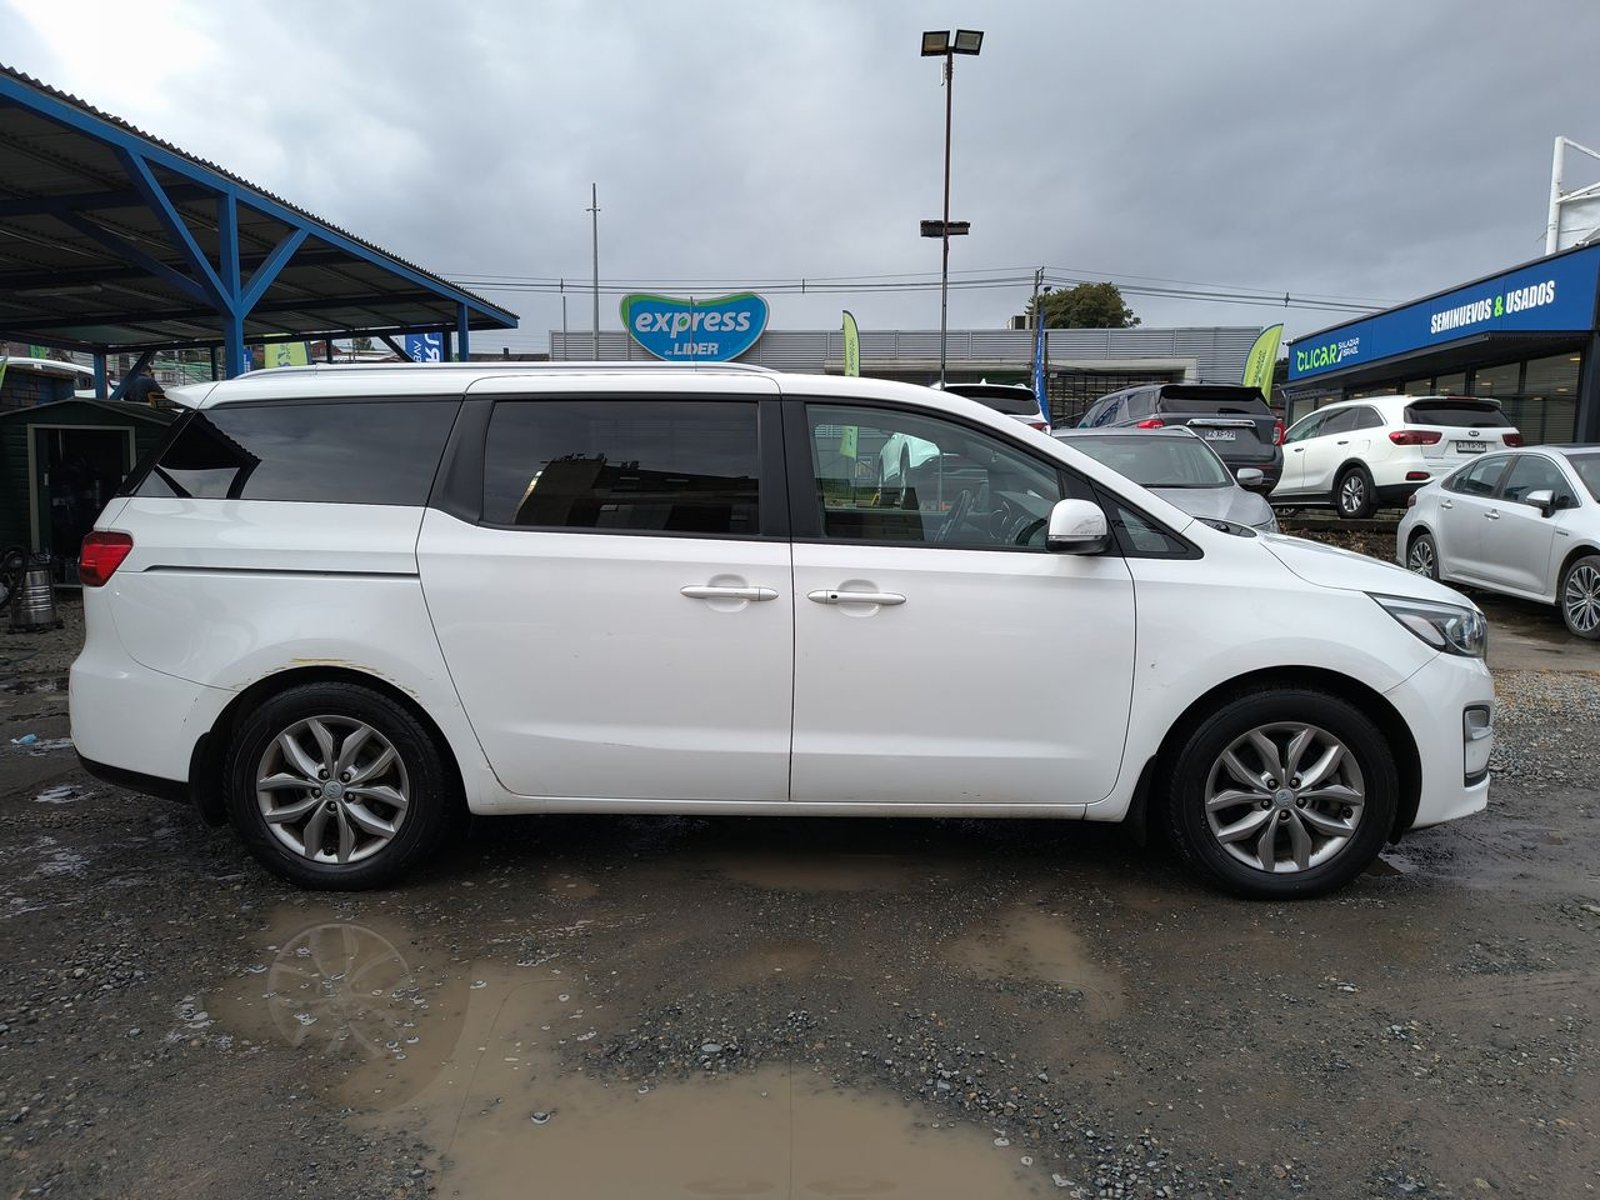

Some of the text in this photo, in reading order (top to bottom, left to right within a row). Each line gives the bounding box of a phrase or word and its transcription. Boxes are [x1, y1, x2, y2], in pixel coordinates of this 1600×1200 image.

[1430, 280, 1555, 334] SEMINUEVOS & USADOS
[635, 311, 751, 339] express
[673, 342, 719, 356] LIDER
